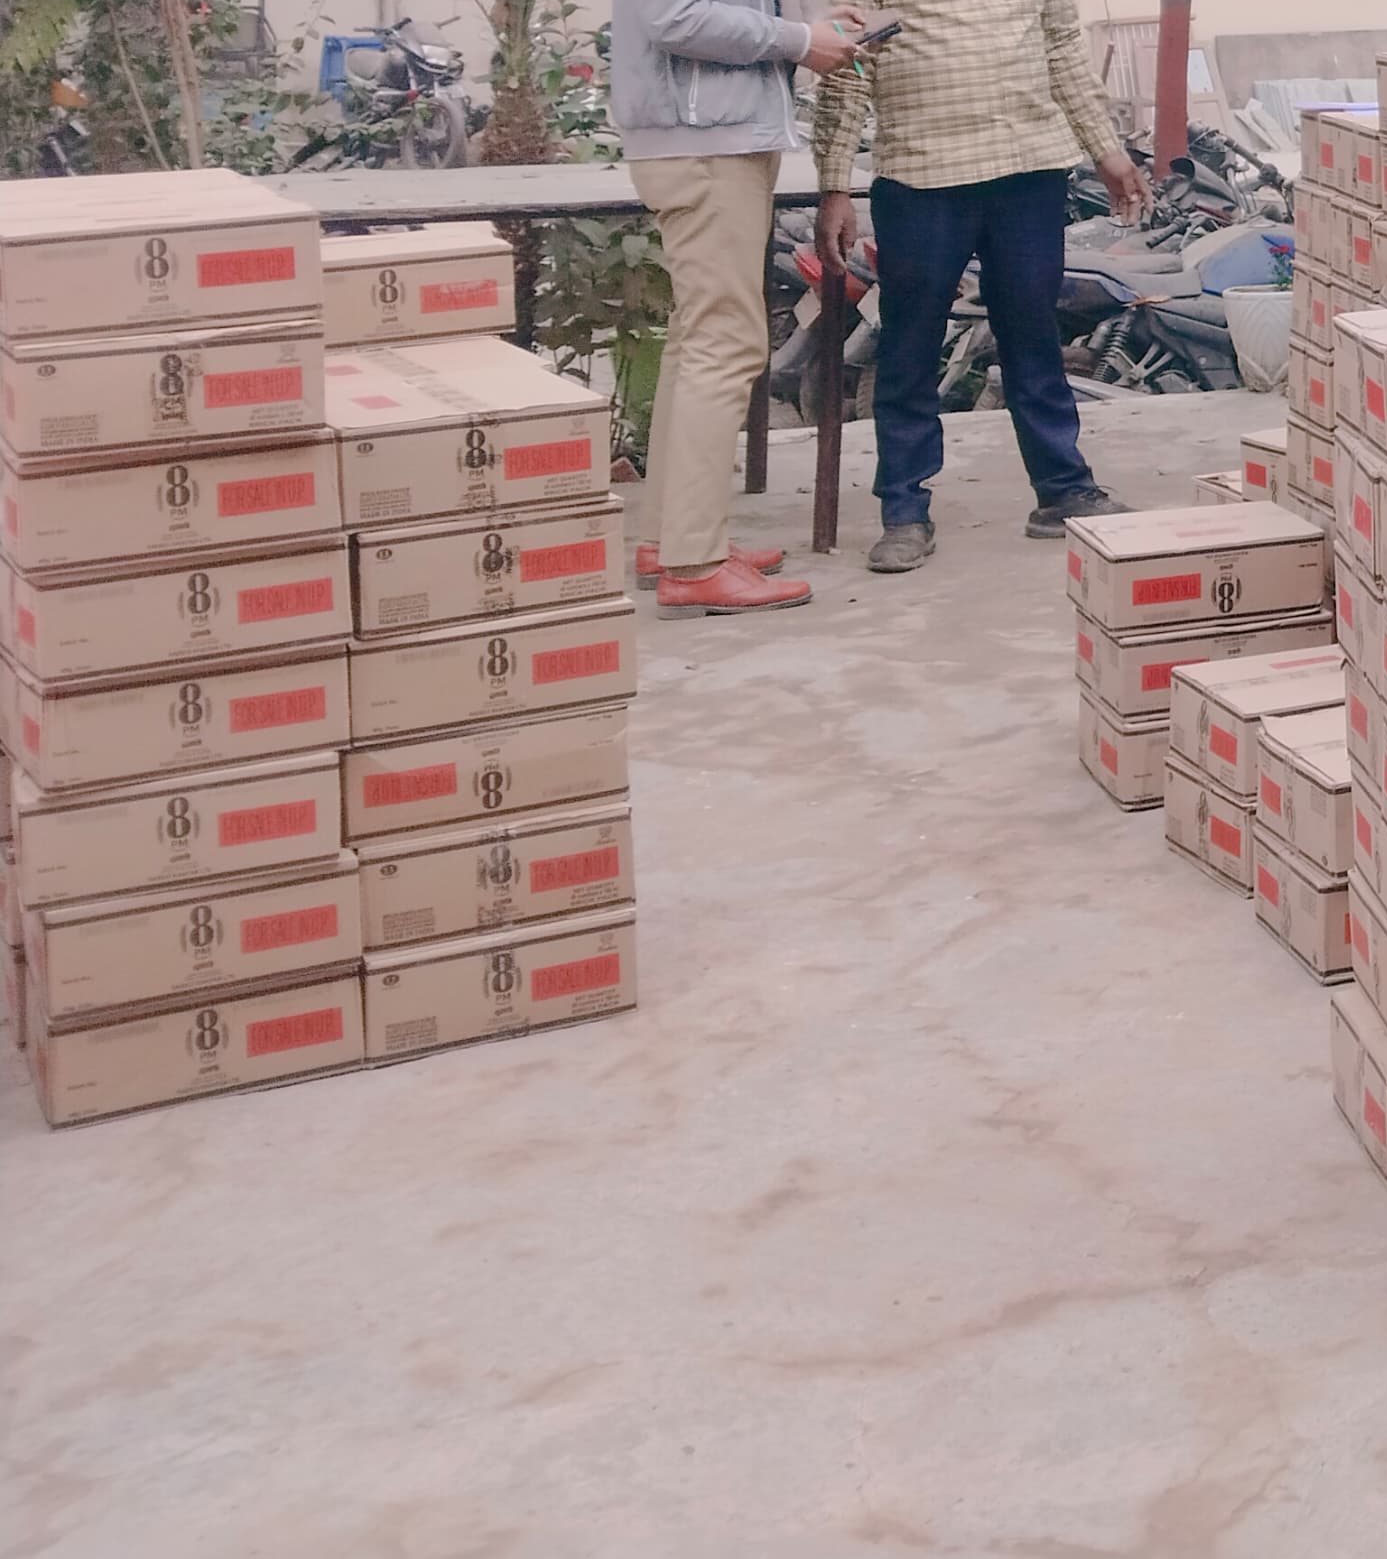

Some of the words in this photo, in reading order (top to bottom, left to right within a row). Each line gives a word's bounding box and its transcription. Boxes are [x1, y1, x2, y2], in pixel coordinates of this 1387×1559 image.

[145, 237, 169, 280] 8
[377, 269, 399, 307] 8
[166, 465, 190, 508] 8
[188, 573, 211, 614] 8
[1218, 582, 1235, 614] 8
[486, 637, 508, 677] 8
[178, 683, 202, 725] 8
[481, 771, 504, 809] 8
[166, 796, 190, 839] 8
[189, 905, 214, 947] 8
[195, 1009, 219, 1051] 8
